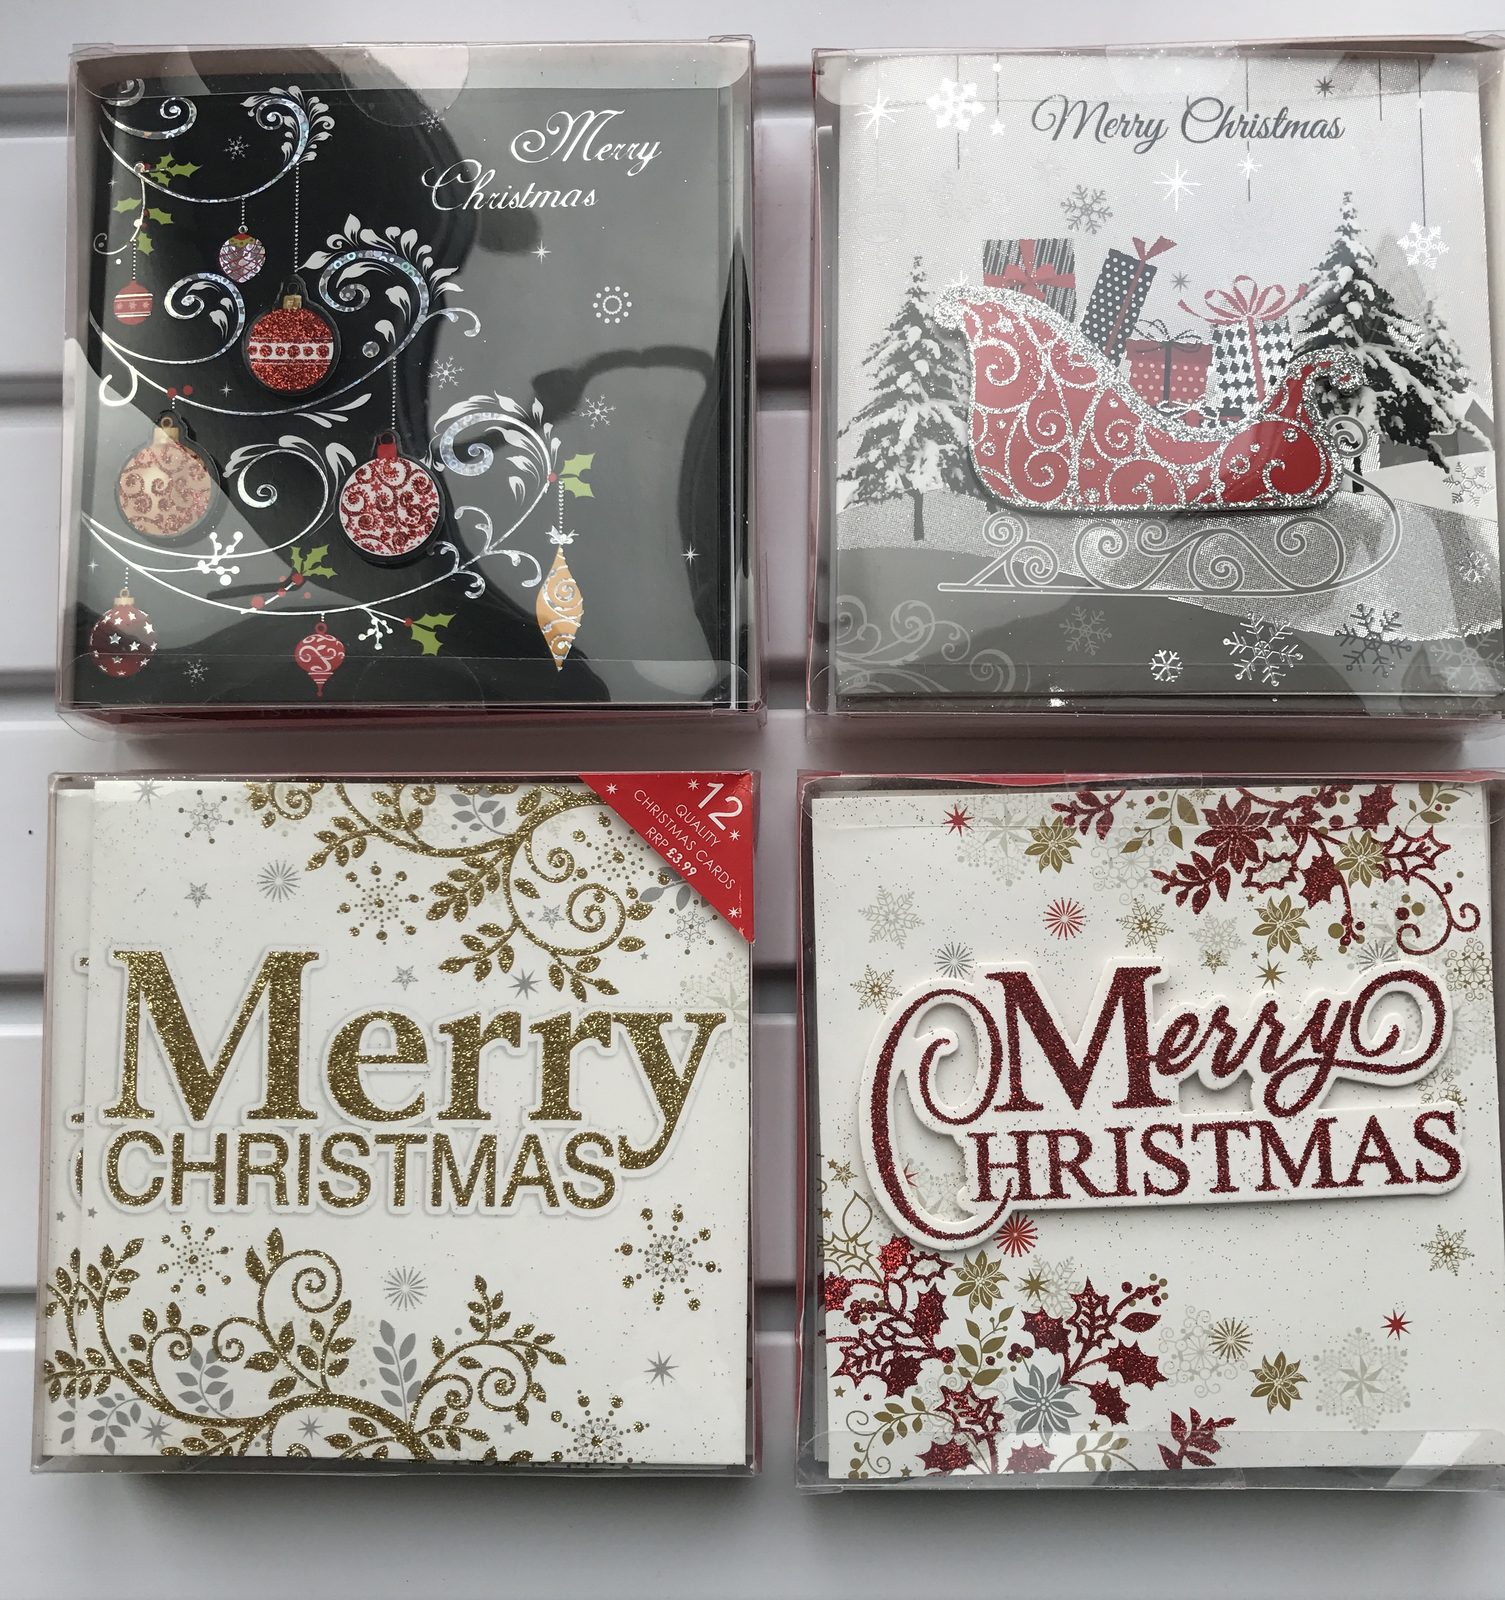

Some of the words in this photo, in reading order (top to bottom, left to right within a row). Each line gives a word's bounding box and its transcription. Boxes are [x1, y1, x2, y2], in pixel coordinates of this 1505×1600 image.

[511, 109, 662, 177] Merry
[1031, 94, 1169, 154] Merry
[1181, 96, 1346, 144] Christmas
[421, 159, 599, 211] Christmas
[634, 789, 697, 851] CHRISTMAS
[695, 849, 736, 890] CARDS
[675, 804, 721, 847] QUALITY
[697, 782, 743, 831] 12
[645, 826, 669, 848] RRP
[666, 847, 697, 877] £3.99
[103, 950, 727, 1170] Merry
[984, 966, 1446, 1118] Merry
[872, 988, 1463, 1241] CHRISTMAS
[106, 1129, 619, 1209] CHRISTMAS
